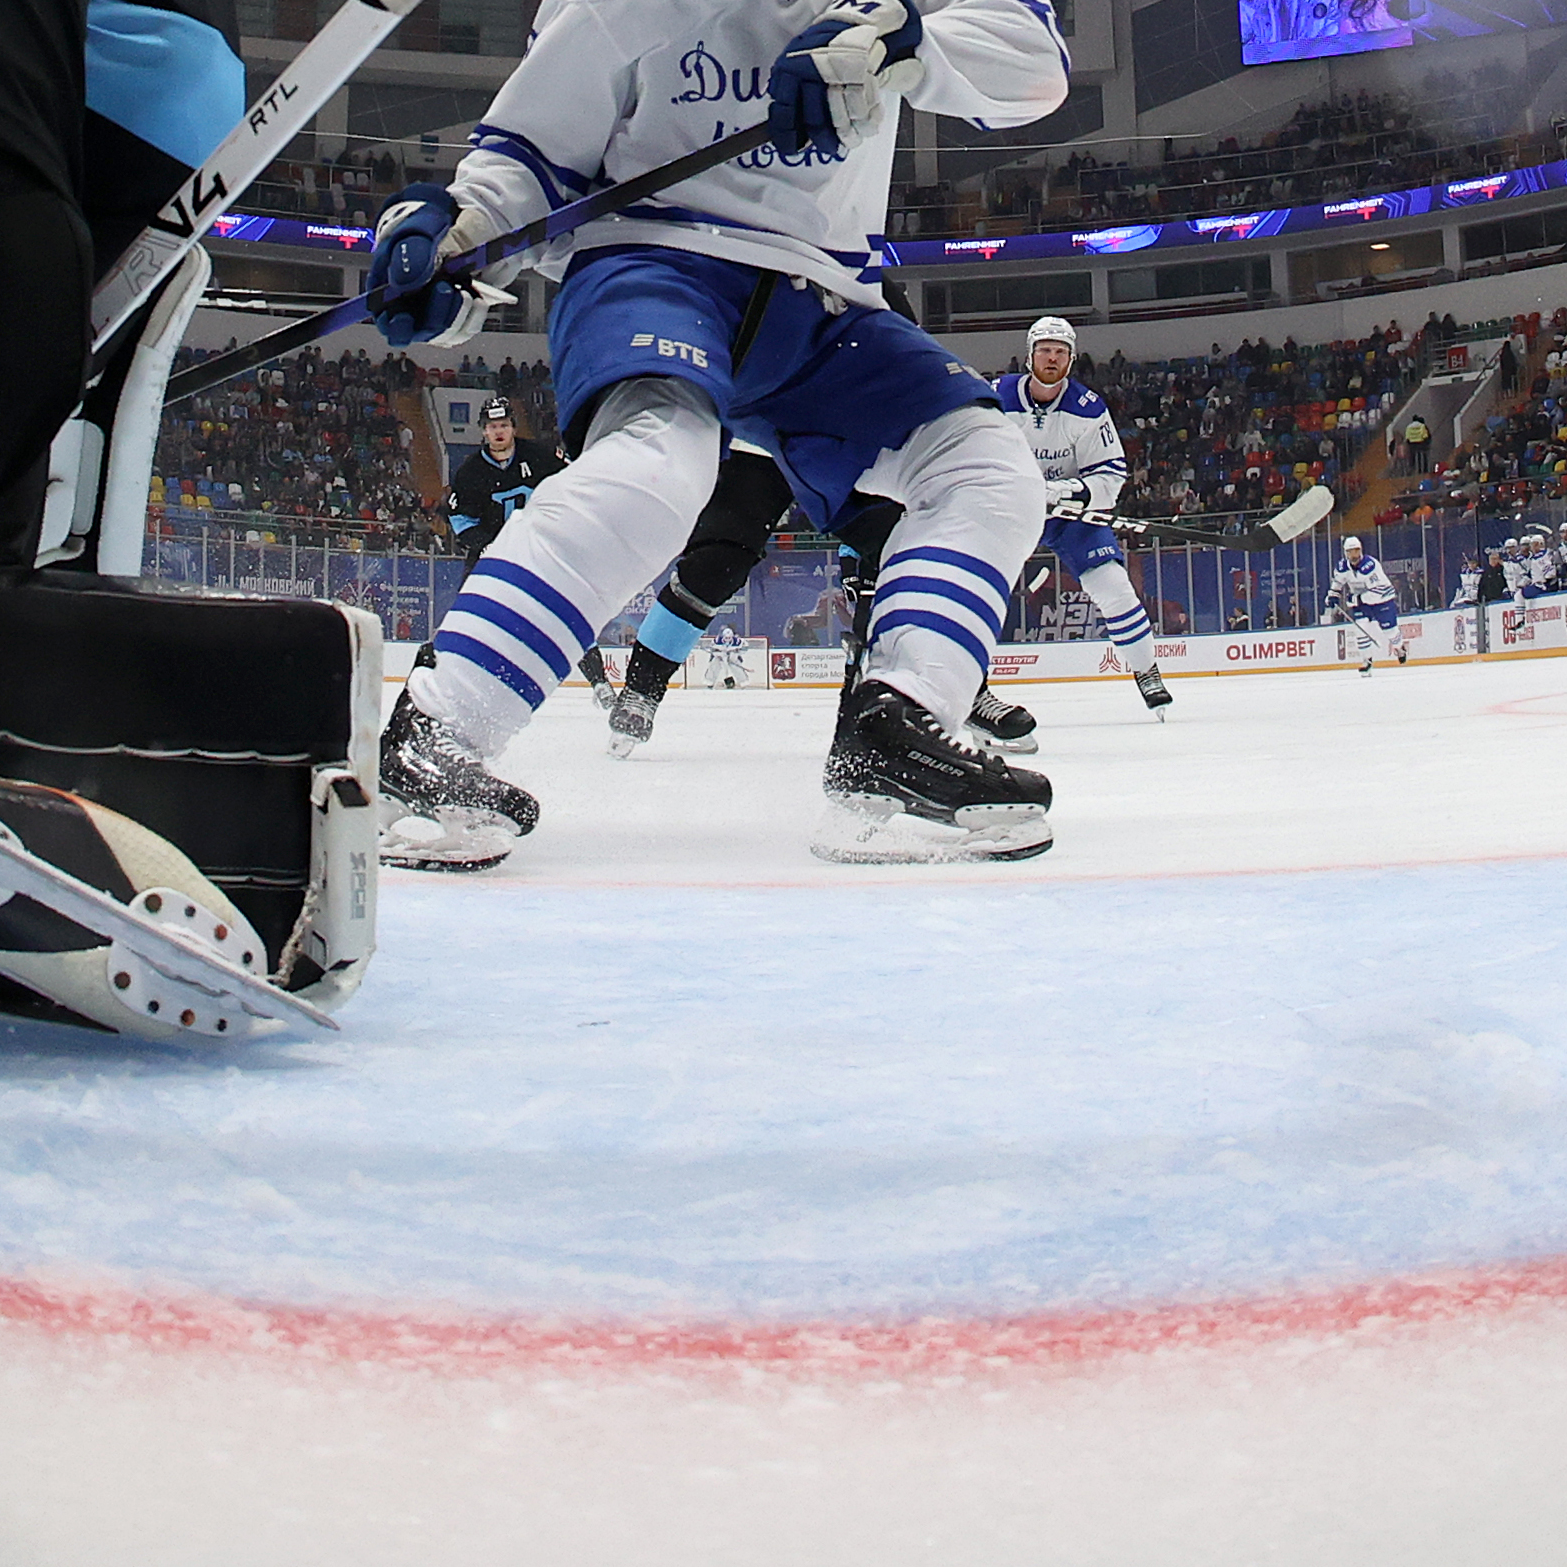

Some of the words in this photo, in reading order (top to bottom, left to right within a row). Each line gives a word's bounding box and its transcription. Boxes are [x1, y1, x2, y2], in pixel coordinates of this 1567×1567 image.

[247, 81, 300, 137] RTL
[1447, 175, 1508, 194] FAHRENHEIT
[147, 168, 230, 239] V4
[1323, 198, 1384, 215] FAHRENHEIT
[307, 225, 369, 239] FAHRENHEIT
[1197, 216, 1259, 232] FAHRENHEIT
[1071, 229, 1134, 244] FAHRENHEIT
[944, 239, 1007, 253] FAHRENHEIT
[658, 337, 709, 369] ВТБ
[1098, 421, 1115, 448] 78
[519, 461, 532, 479] A
[1051, 505, 1150, 534] CCM
[1058, 590, 1092, 604] КУБ
[1225, 639, 1316, 661] OLIMPBET
